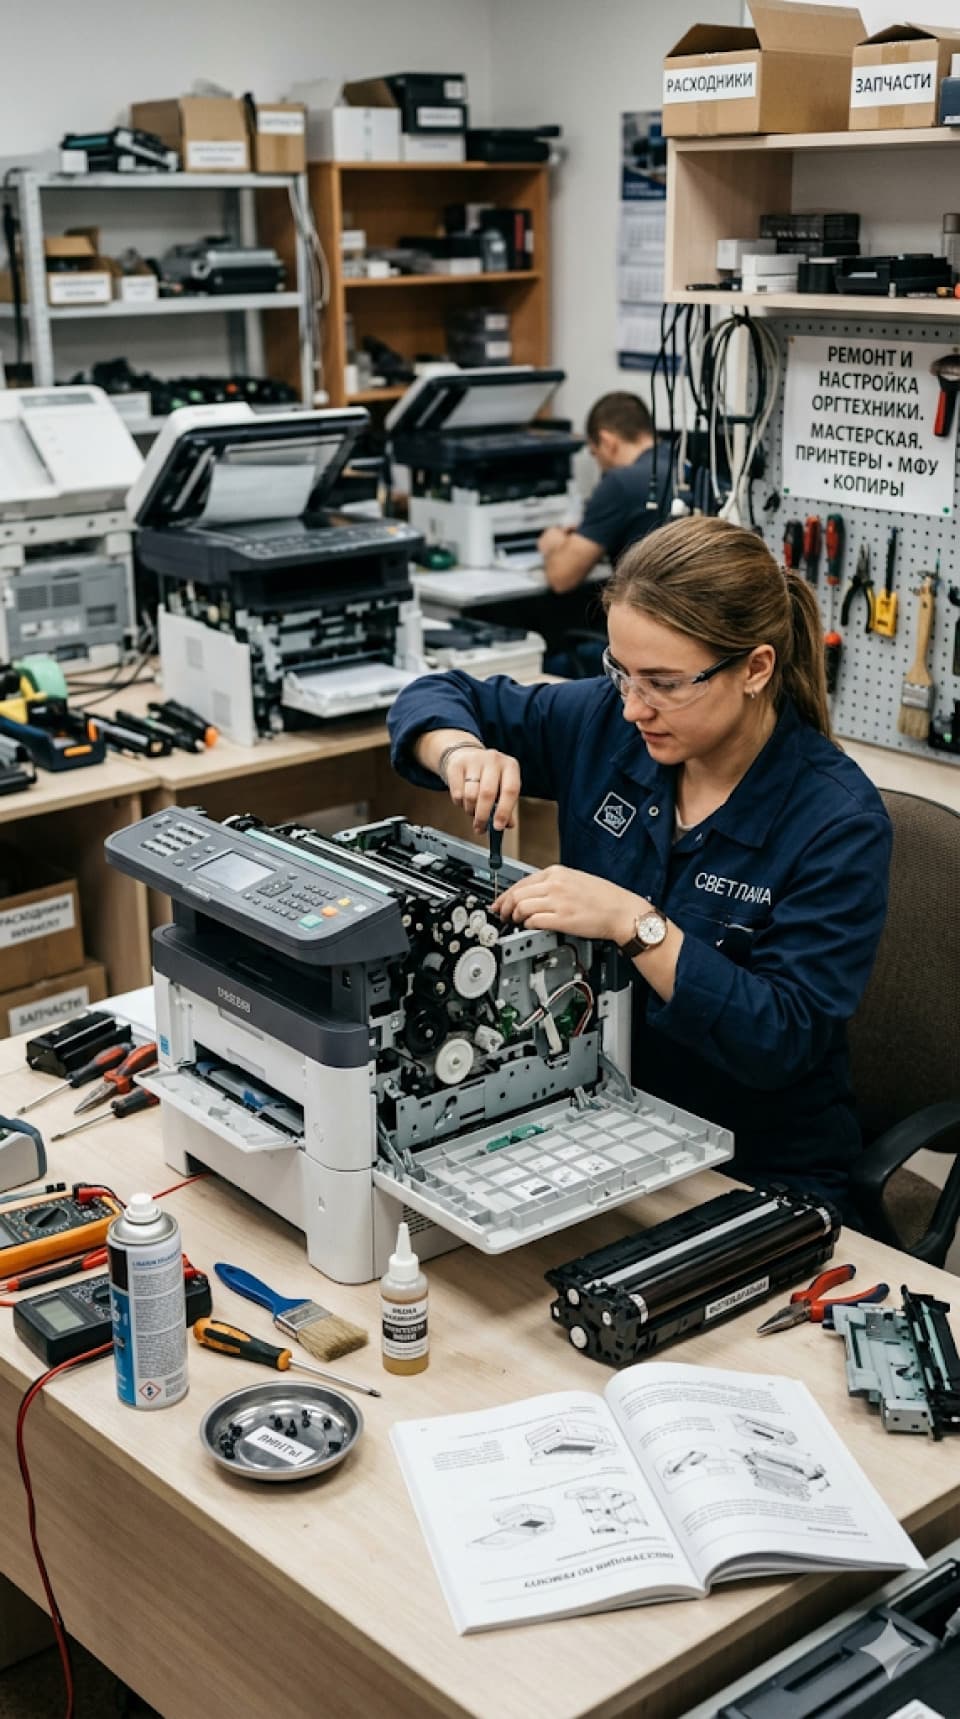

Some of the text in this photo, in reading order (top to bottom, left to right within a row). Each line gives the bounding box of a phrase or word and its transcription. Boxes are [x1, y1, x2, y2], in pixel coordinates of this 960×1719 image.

[666, 71, 753, 94] РАСХОДНИКИ
[855, 73, 932, 94] ЗАПЧАСТИ
[828, 346, 913, 369] РЕМОНТ И
[819, 371, 919, 394] НАСТРОЙКА
[812, 395, 924, 421] ОРГТЕХНИКИ.
[810, 423, 923, 450] МАСТЕРСКАЯ.
[795, 444, 939, 476] ПРИНТЕРЫ МФУ
[833, 474, 904, 497] КОПИРЫ
